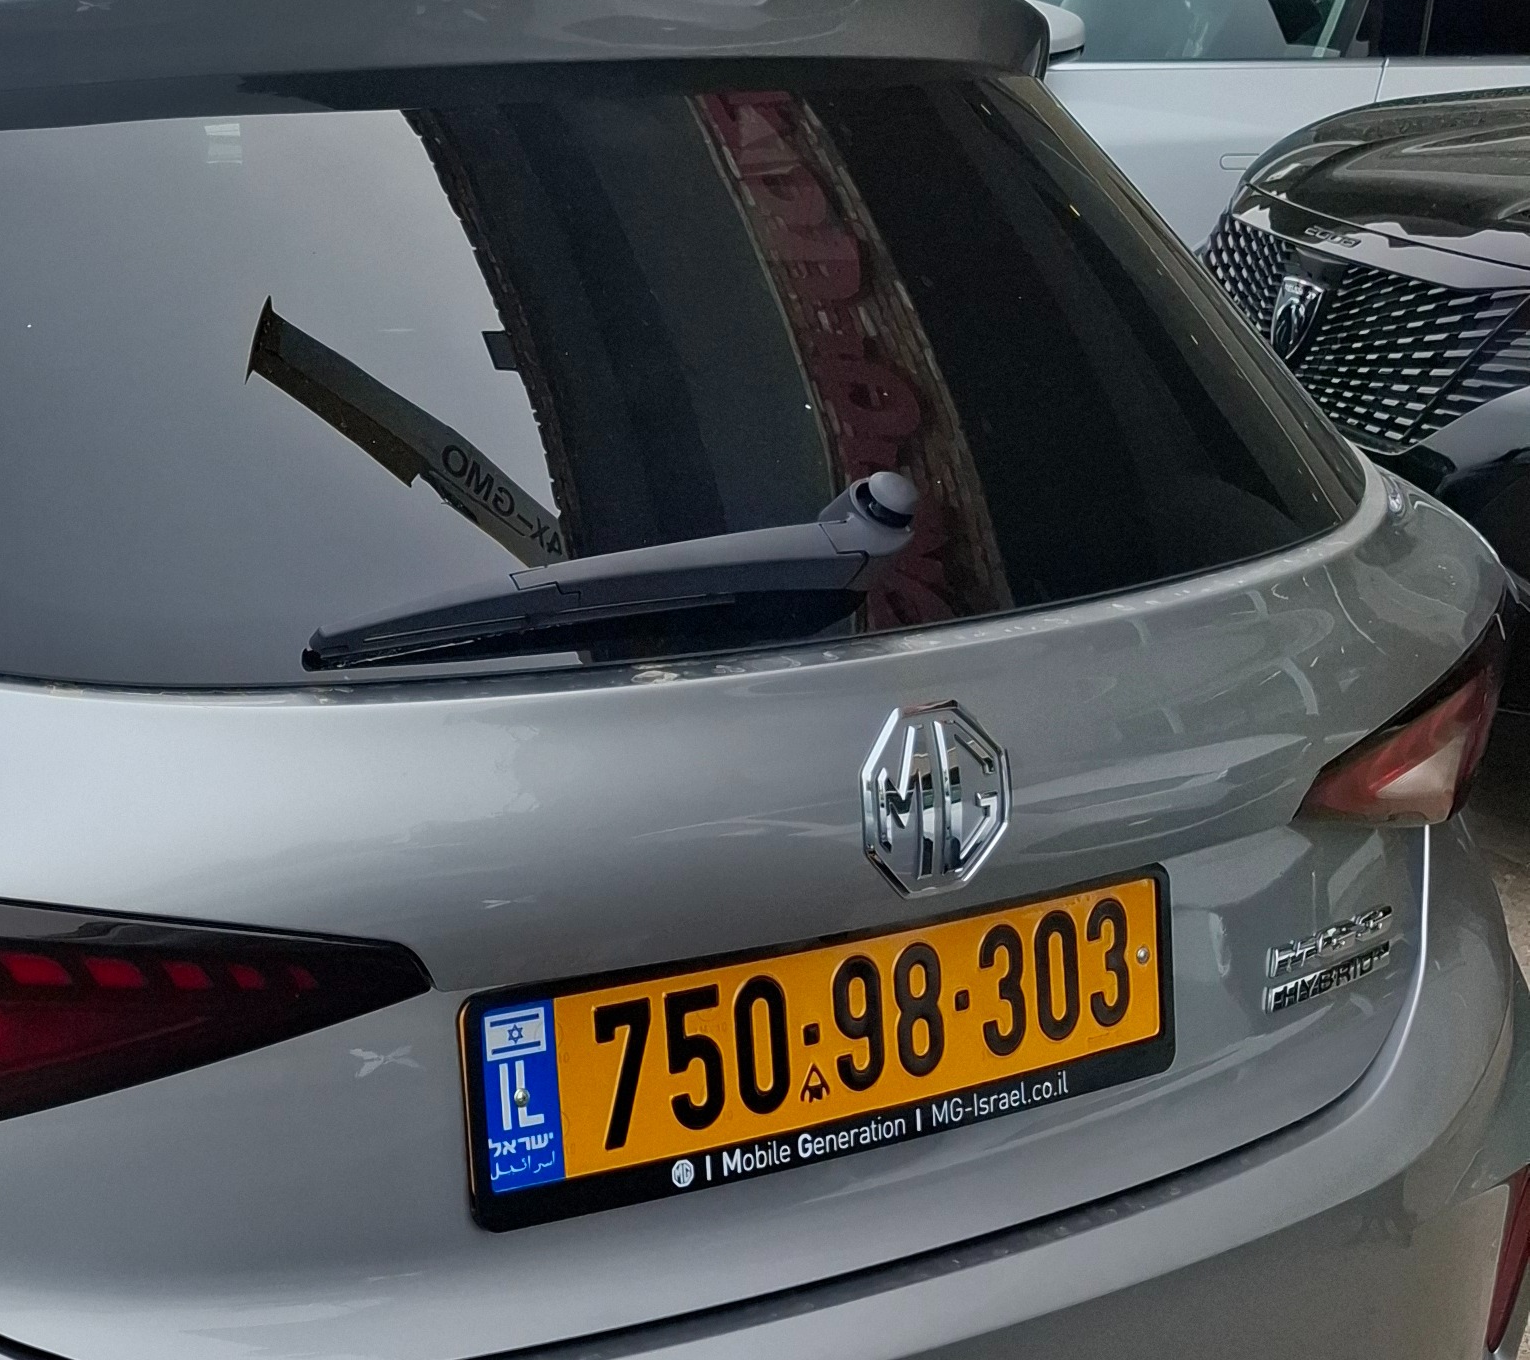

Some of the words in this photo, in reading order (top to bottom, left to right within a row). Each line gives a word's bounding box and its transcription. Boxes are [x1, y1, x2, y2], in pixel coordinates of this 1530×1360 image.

[875, 720, 1000, 881] MG
[499, 1059, 545, 1131] IL
[722, 1141, 791, 1177] Mobile
[797, 1116, 906, 1158] Generation
[932, 1070, 1069, 1128] MG-Israel.co.il
[487, 1132, 554, 1158] ישראל
